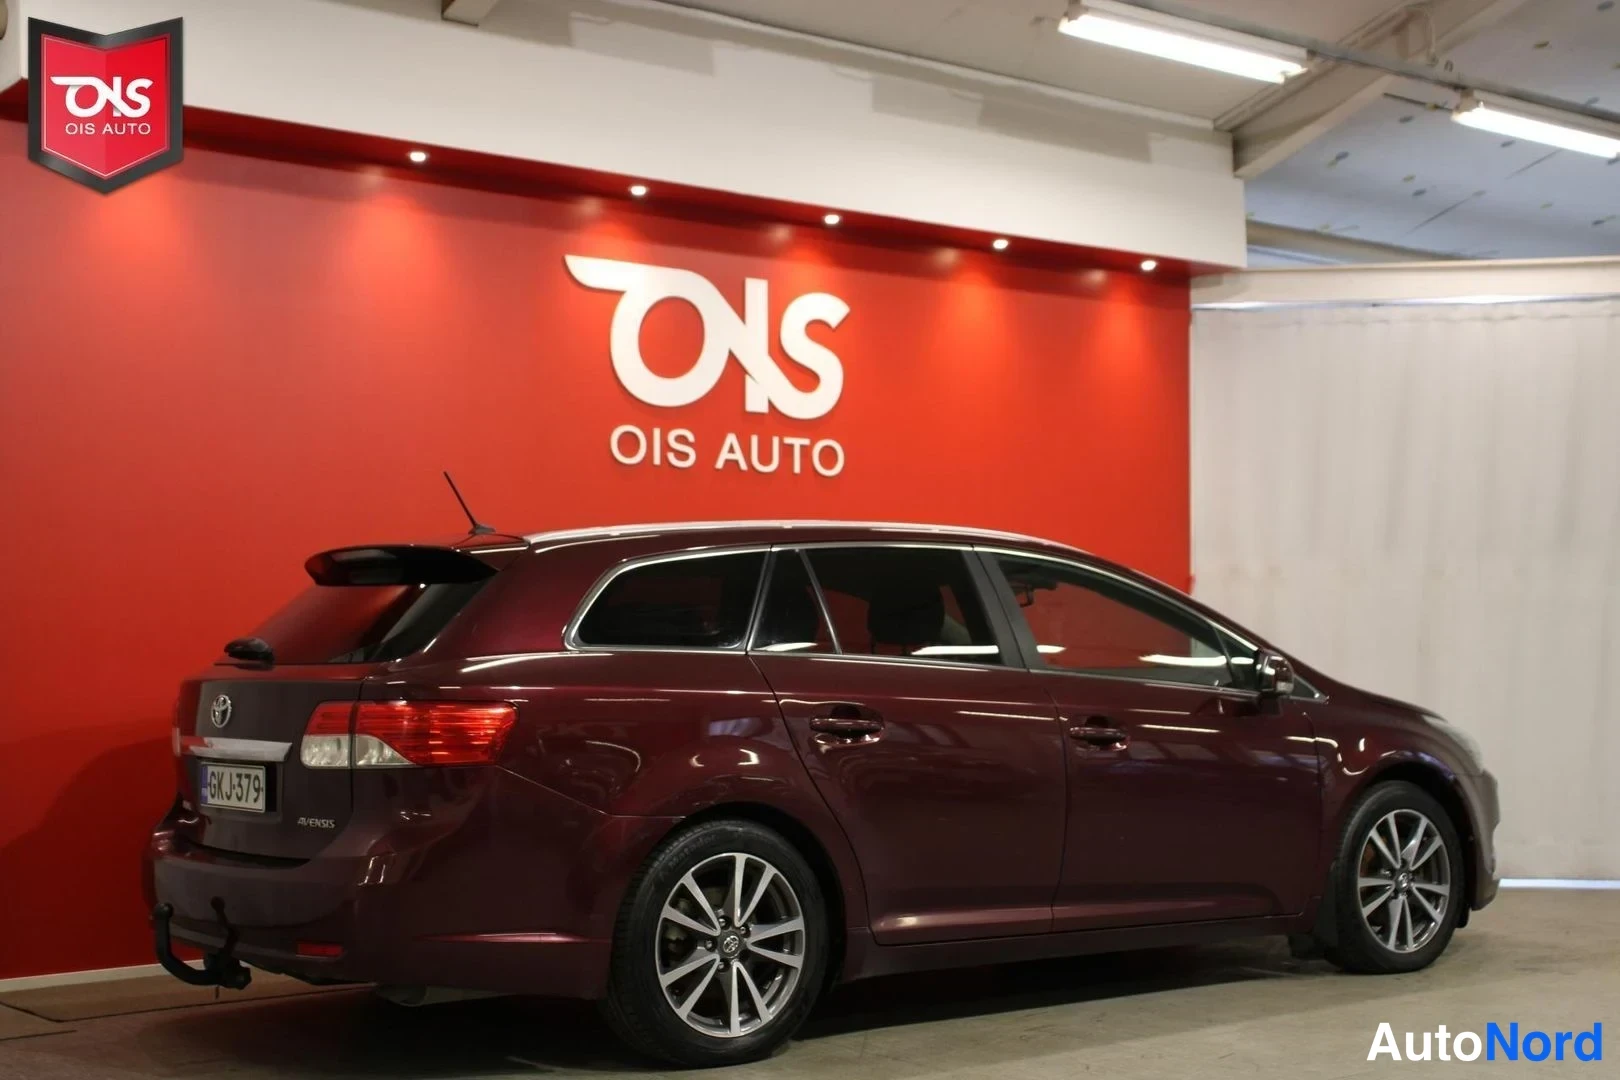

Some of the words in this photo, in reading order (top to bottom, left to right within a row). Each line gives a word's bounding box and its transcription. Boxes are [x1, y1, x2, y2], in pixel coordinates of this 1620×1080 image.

[564, 254, 850, 419] OIS
[610, 424, 696, 468] OIS
[715, 433, 845, 477] AUTO
[209, 770, 262, 804] GKJ-379
[297, 816, 336, 829] AVENSIS
